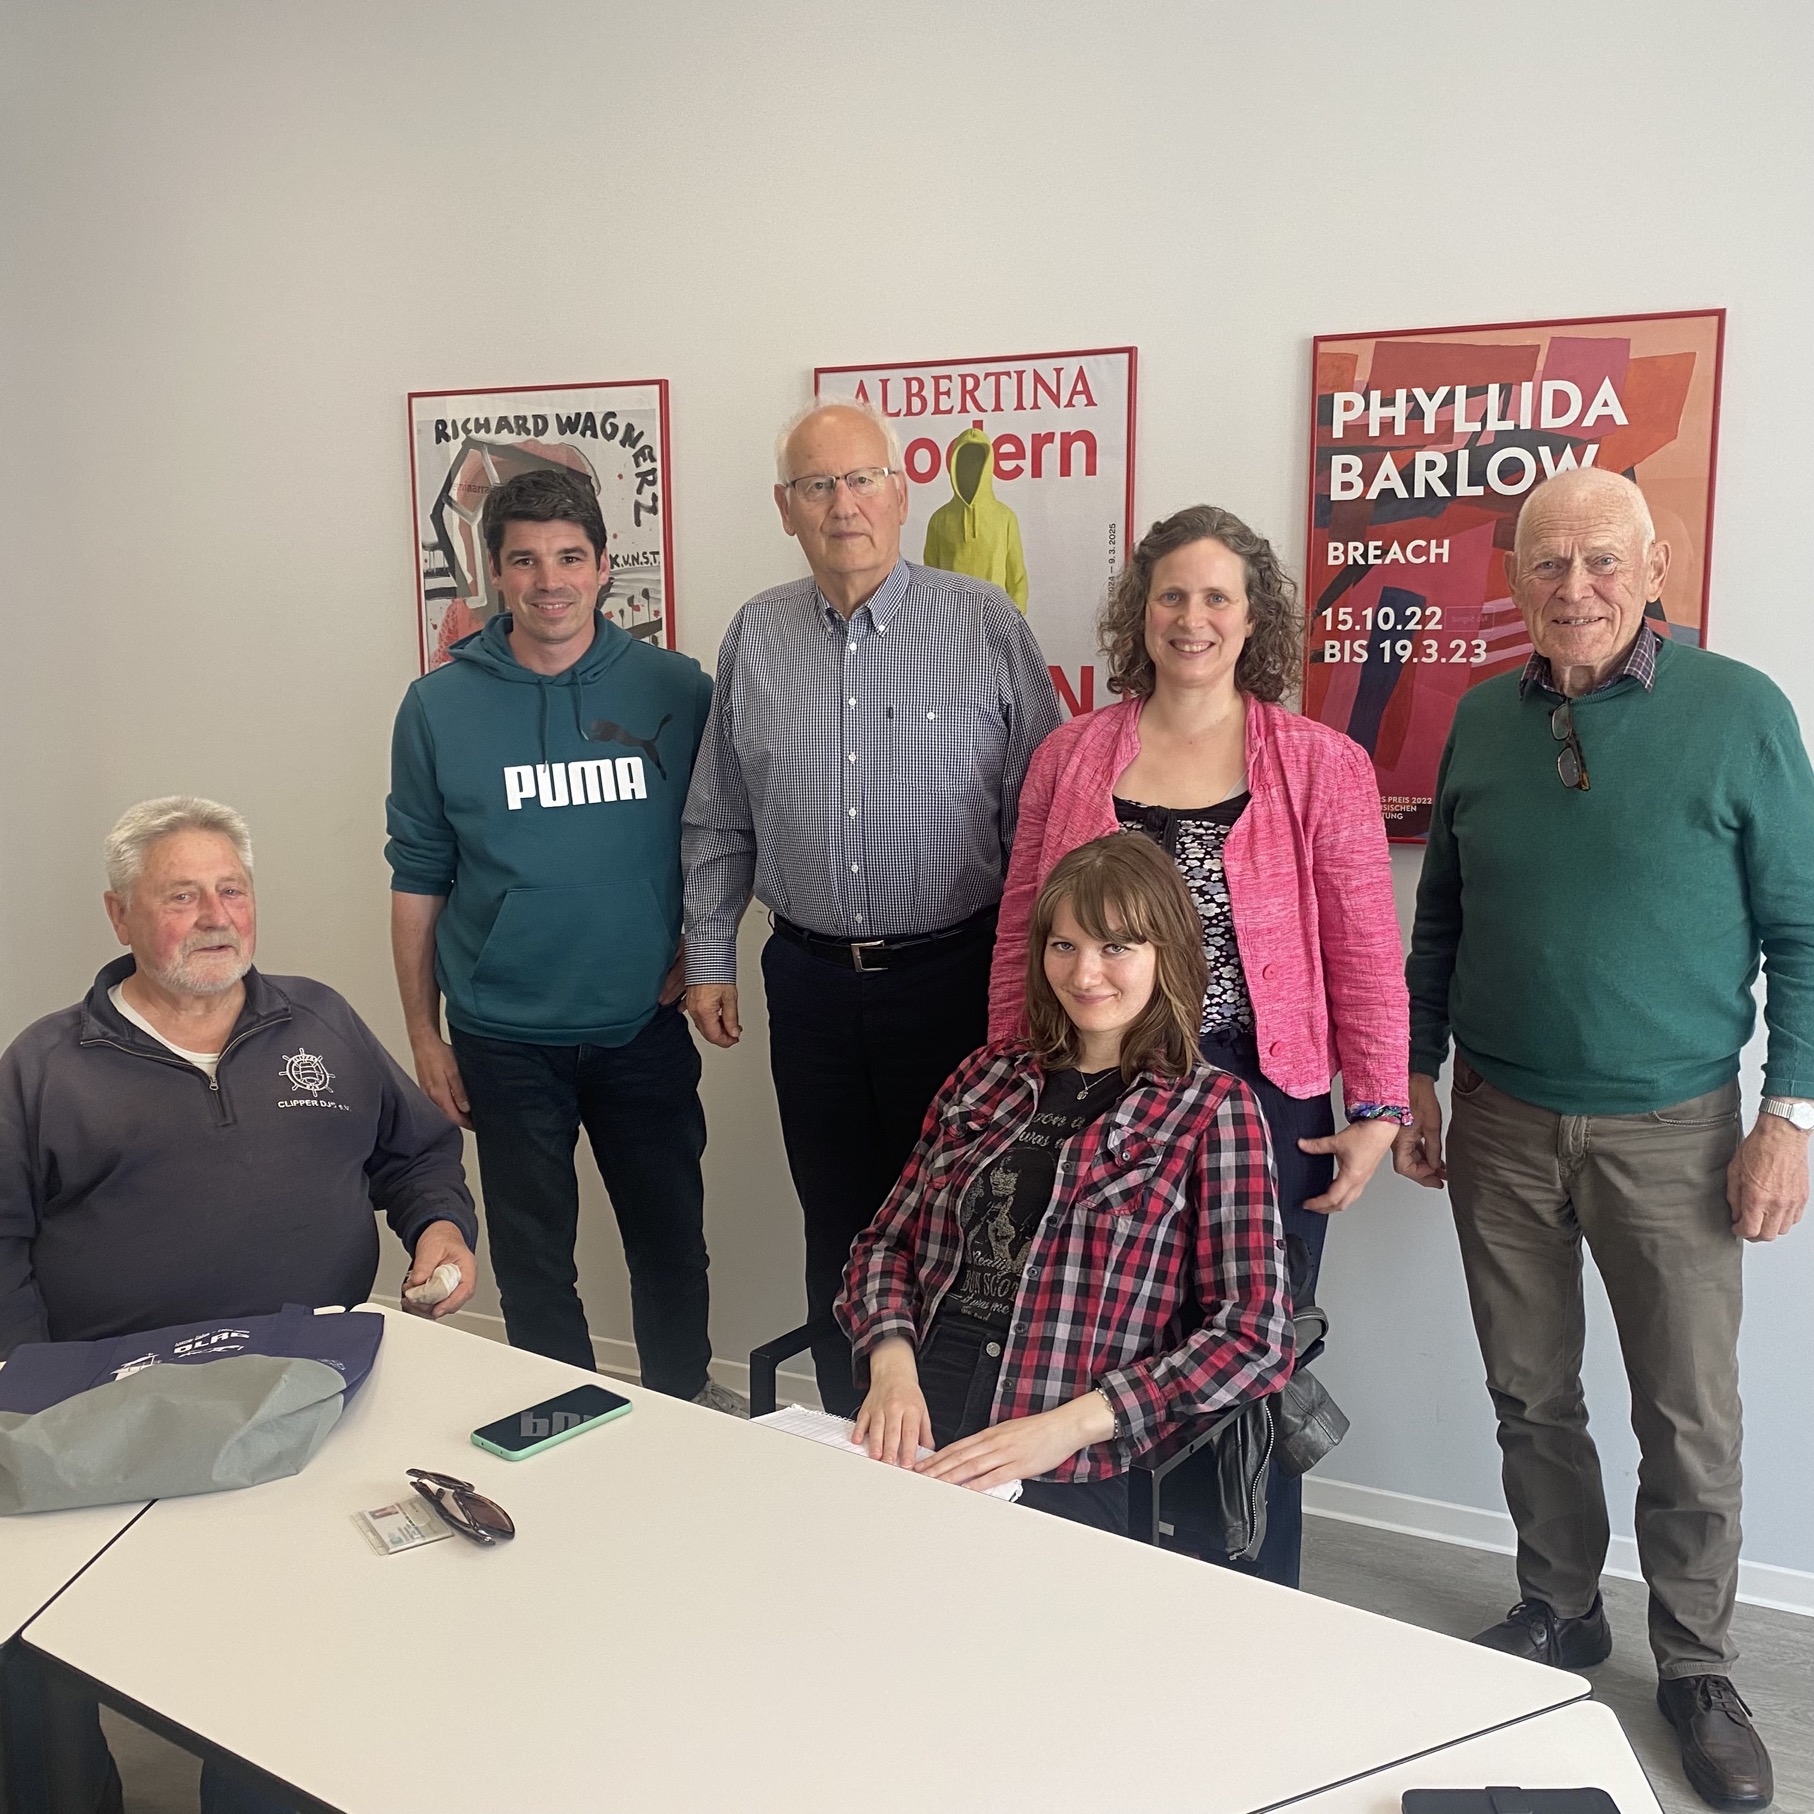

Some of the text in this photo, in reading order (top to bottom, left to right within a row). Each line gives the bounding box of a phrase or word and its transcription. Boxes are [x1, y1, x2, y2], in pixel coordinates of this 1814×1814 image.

[855, 365, 1098, 418] ALBERTINA
[1331, 375, 1629, 439] PHYLLIDA
[434, 411, 659, 528] RICHARD WAGNERZ
[1327, 539, 1450, 566] BREACH
[1321, 606, 1443, 631] 15.10.22
[1323, 639, 1487, 664] BIS 19.3.23
[503, 756, 648, 811] PUMA
[1380, 804, 1417, 812] SISCHEN
[1388, 796, 1410, 804] PREIS
[277, 1099, 319, 1108] CLIPPER
[983, 1272, 1019, 1302] SCOT
